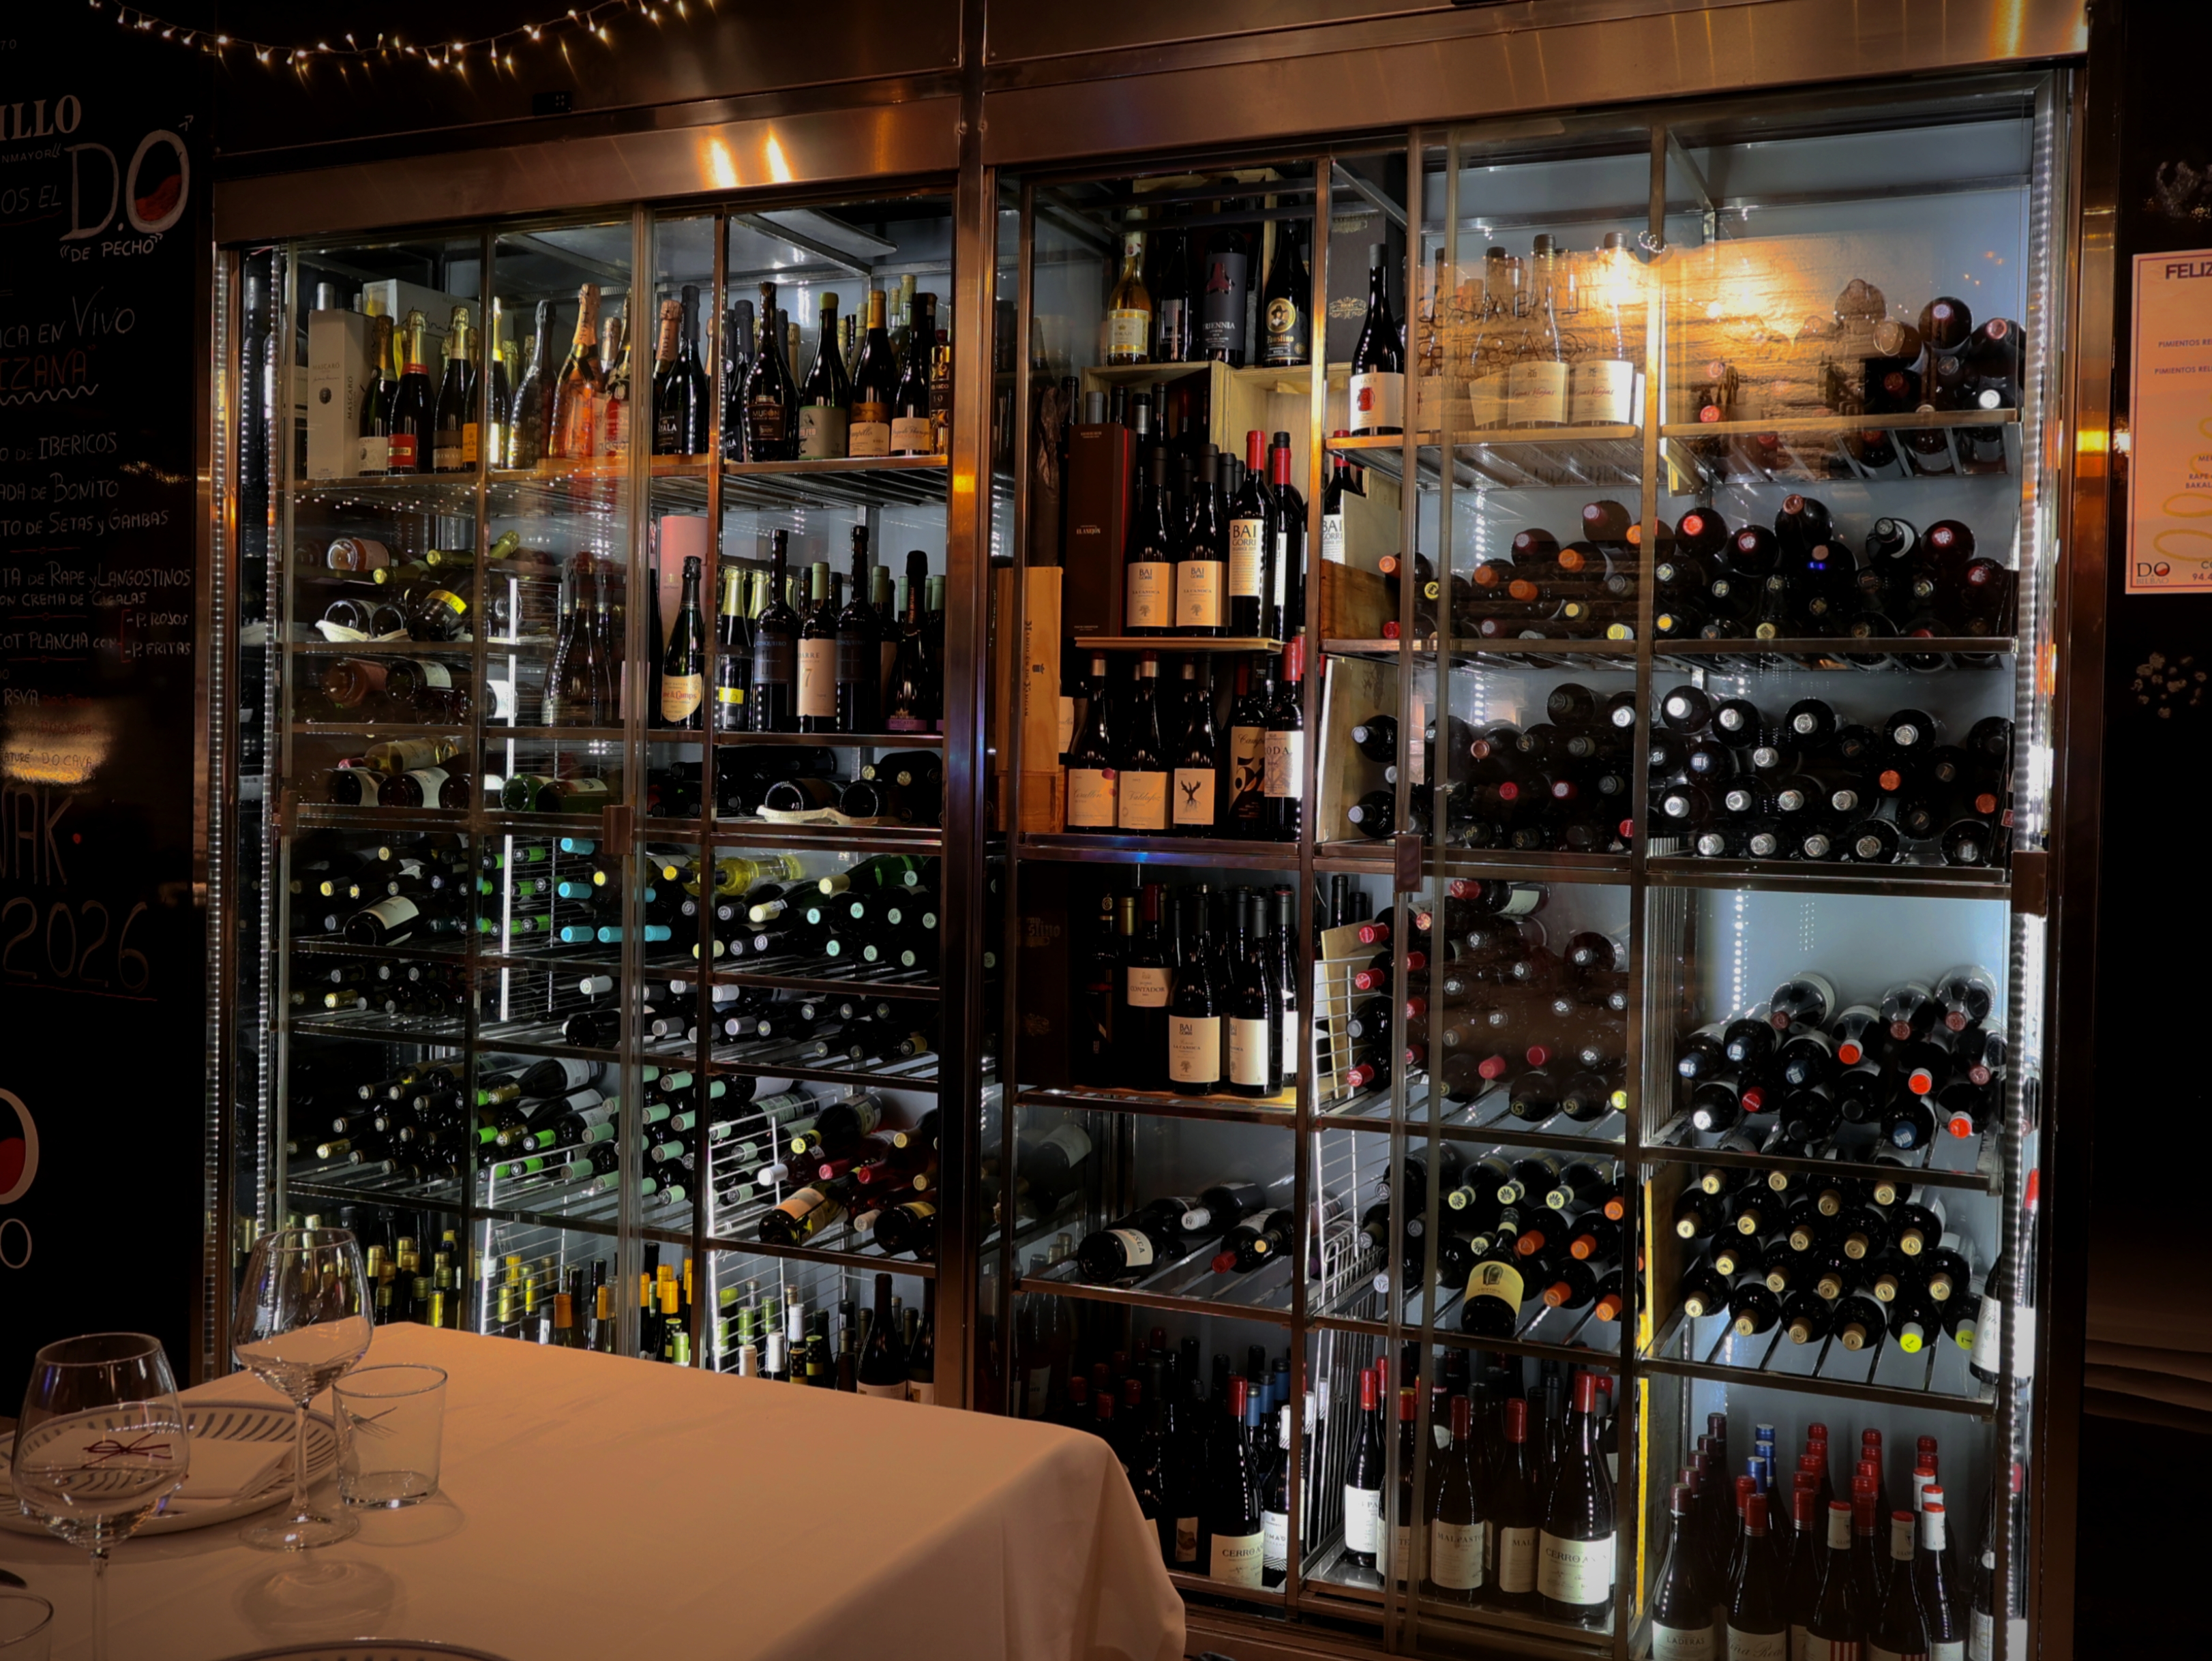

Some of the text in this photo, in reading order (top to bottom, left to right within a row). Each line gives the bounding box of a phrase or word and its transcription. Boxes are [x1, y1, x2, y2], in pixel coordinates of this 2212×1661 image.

[38, 184, 62, 209] EL
[38, 320, 67, 344] EN
[2158, 339, 2200, 348] PIMIENTOS
[2154, 366, 2196, 375] PIMIENTOS
[15, 447, 35, 462] DE
[38, 429, 118, 460] IBERICOS
[30, 485, 48, 501] DE
[48, 471, 120, 504] BONITO
[25, 520, 44, 537] DE
[48, 511, 95, 535] SETAS
[108, 507, 170, 531] GAMBAS
[1232, 524, 1257, 539] BAI
[1231, 538, 1257, 547] GORRI
[27, 573, 46, 586] DE
[44, 560, 86, 588] RAPE
[97, 562, 192, 588] LANGOSTINOS
[1139, 568, 1153, 576] BAI
[1190, 567, 1205, 575] BAI
[2136, 577, 2170, 585] BILBAO
[20, 593, 67, 608] CREMA
[70, 593, 85, 606] DE
[149, 610, 189, 627] ROJOS
[29, 632, 89, 650] PLANCHA
[92, 635, 117, 648] CON
[145, 640, 191, 657] FRITAS
[2, 896, 150, 994] 2026
[1179, 1023, 1193, 1032] BAI
[1222, 1548, 1255, 1558] CERRO
[1545, 1548, 1581, 1563] CERRO
[1667, 1636, 1705, 1646] LADERAS
